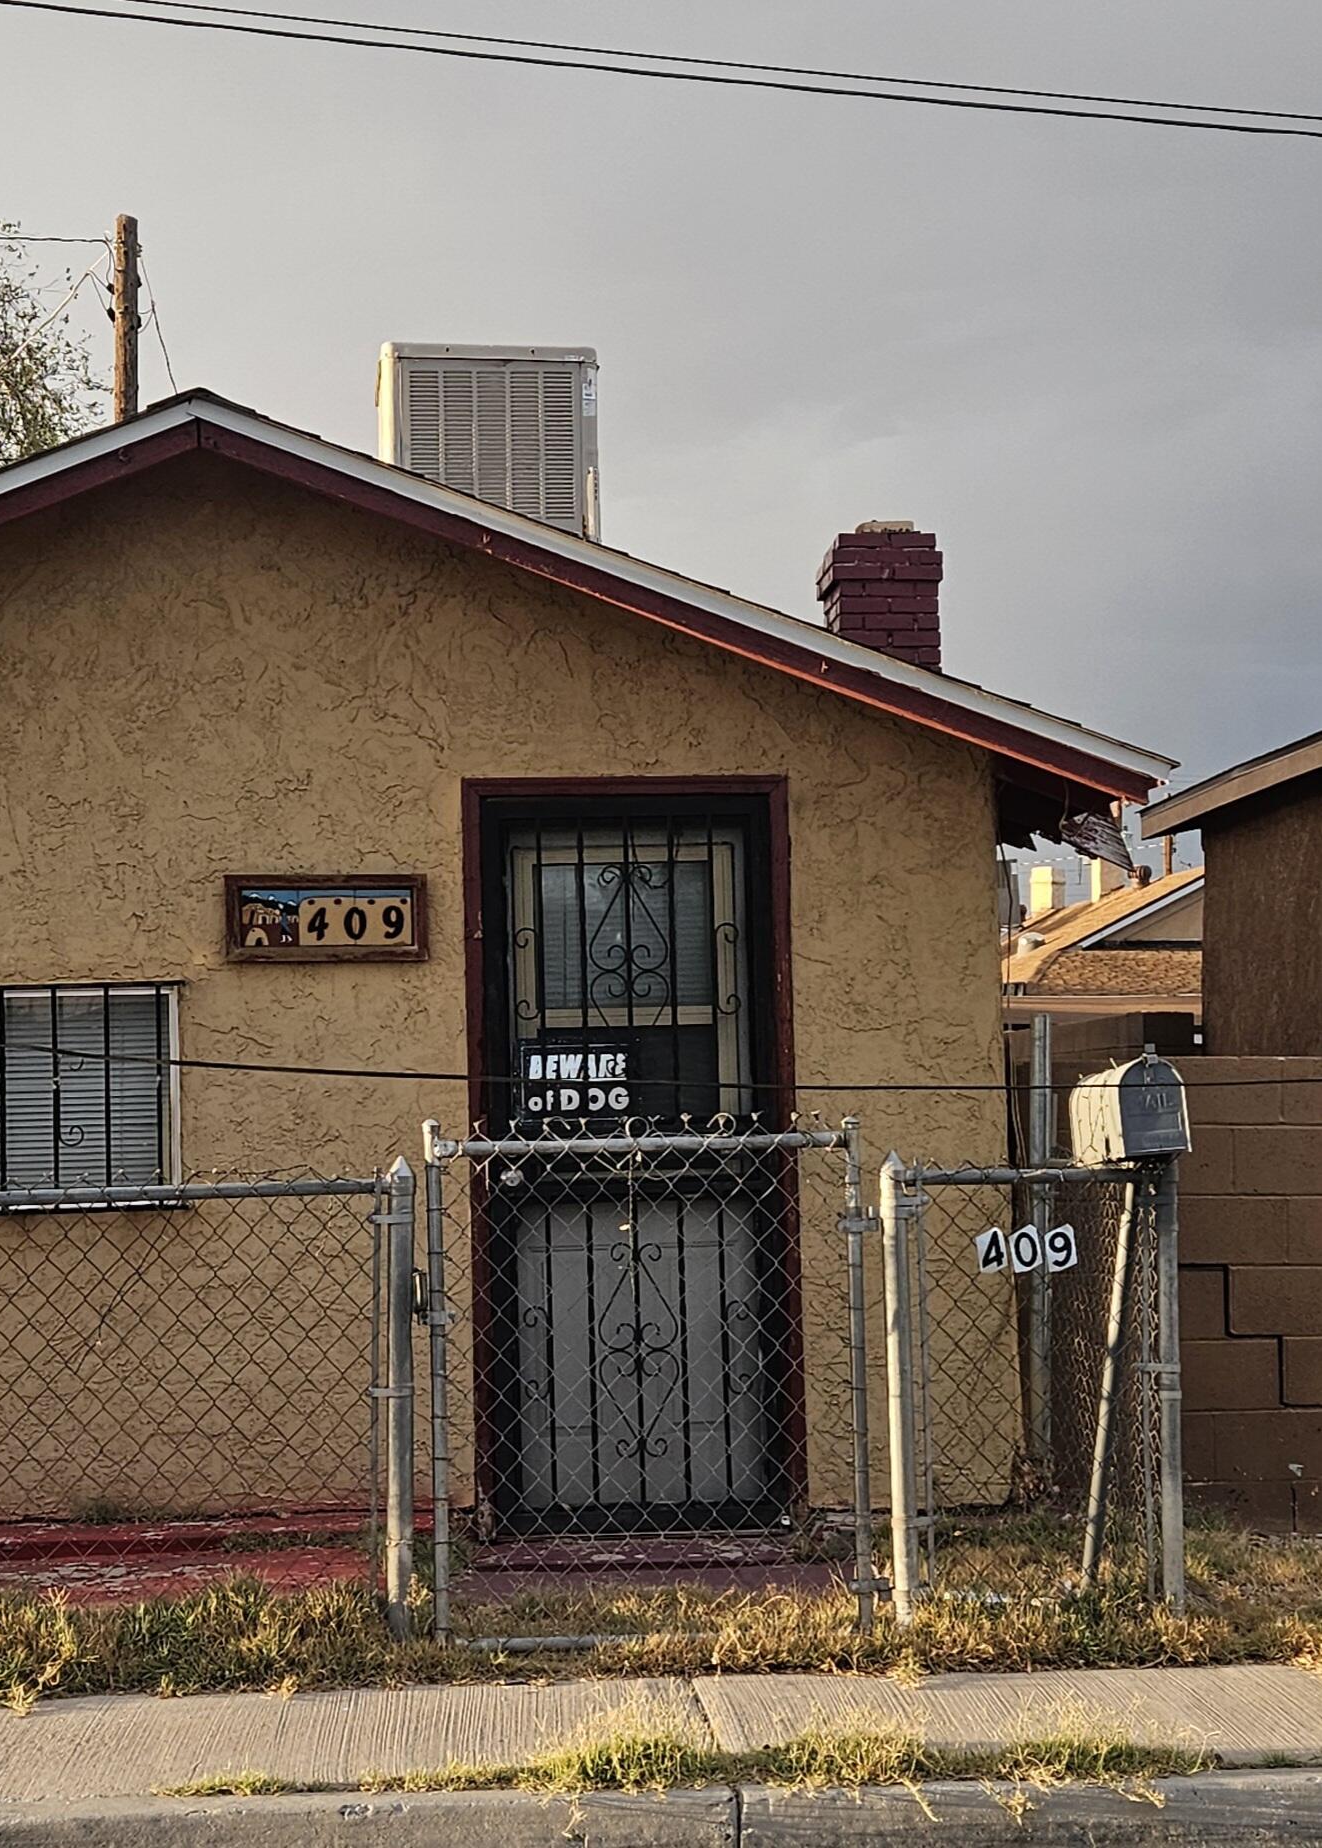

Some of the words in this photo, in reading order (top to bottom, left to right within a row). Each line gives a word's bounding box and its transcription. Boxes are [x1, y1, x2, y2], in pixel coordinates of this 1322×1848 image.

[307, 905, 405, 941] 409
[528, 1090, 554, 1112] of
[559, 1087, 630, 1111] DOG
[981, 1230, 1072, 1269] 409
